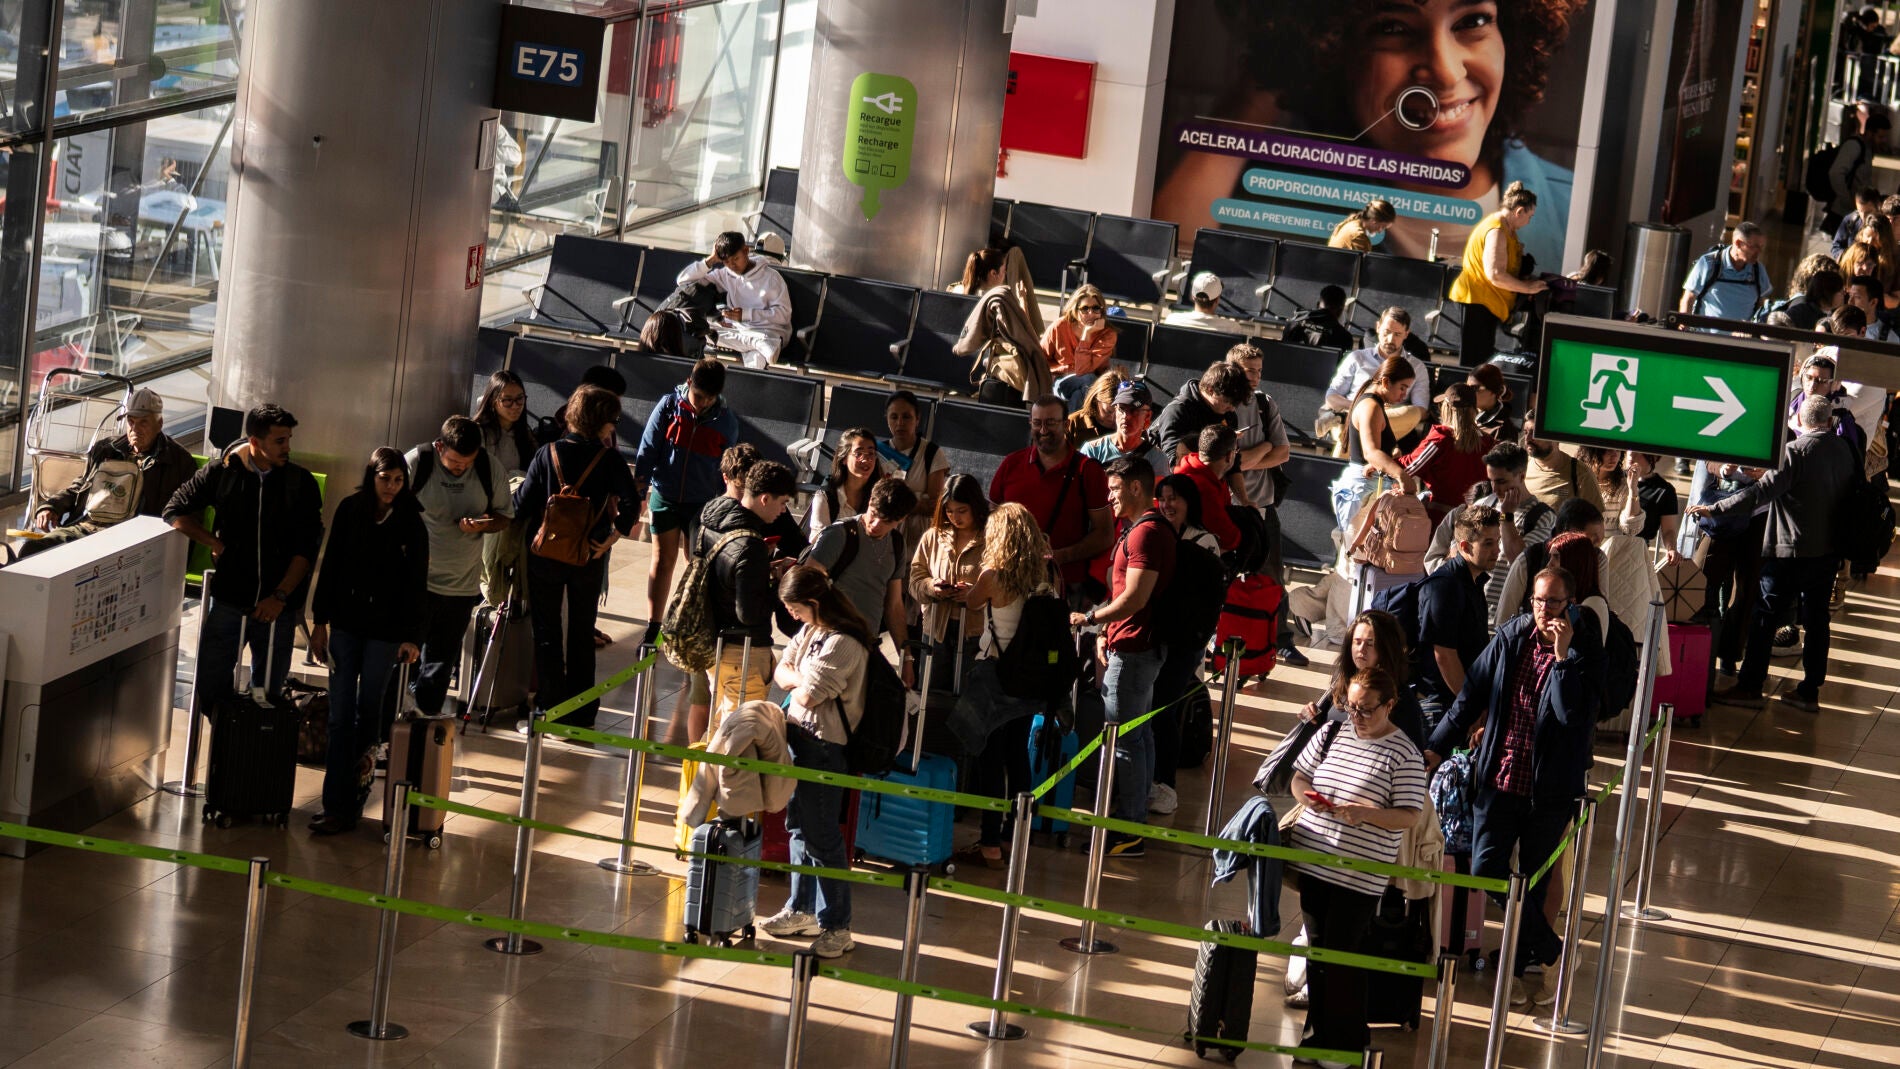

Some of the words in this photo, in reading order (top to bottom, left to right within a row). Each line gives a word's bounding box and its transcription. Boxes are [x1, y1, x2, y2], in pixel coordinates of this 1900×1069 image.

[517, 47, 578, 81] E75
[860, 112, 902, 127] Recargue
[858, 135, 900, 151] Recharge
[1180, 129, 1247, 151] ACELERA
[1250, 140, 1269, 155] LA
[1271, 142, 1344, 166] CURACIÓN
[1347, 155, 1365, 169] DE
[1368, 157, 1397, 174] LAS
[1249, 175, 1341, 199] PROPORCIONA
[1413, 199, 1430, 214] DE
[1433, 203, 1476, 220] ALIVIO
[1218, 206, 1252, 220] AYUDA
[1253, 211, 1260, 220] A
[1262, 212, 1310, 229] PREVENIR
[1312, 219, 1325, 231] EL
